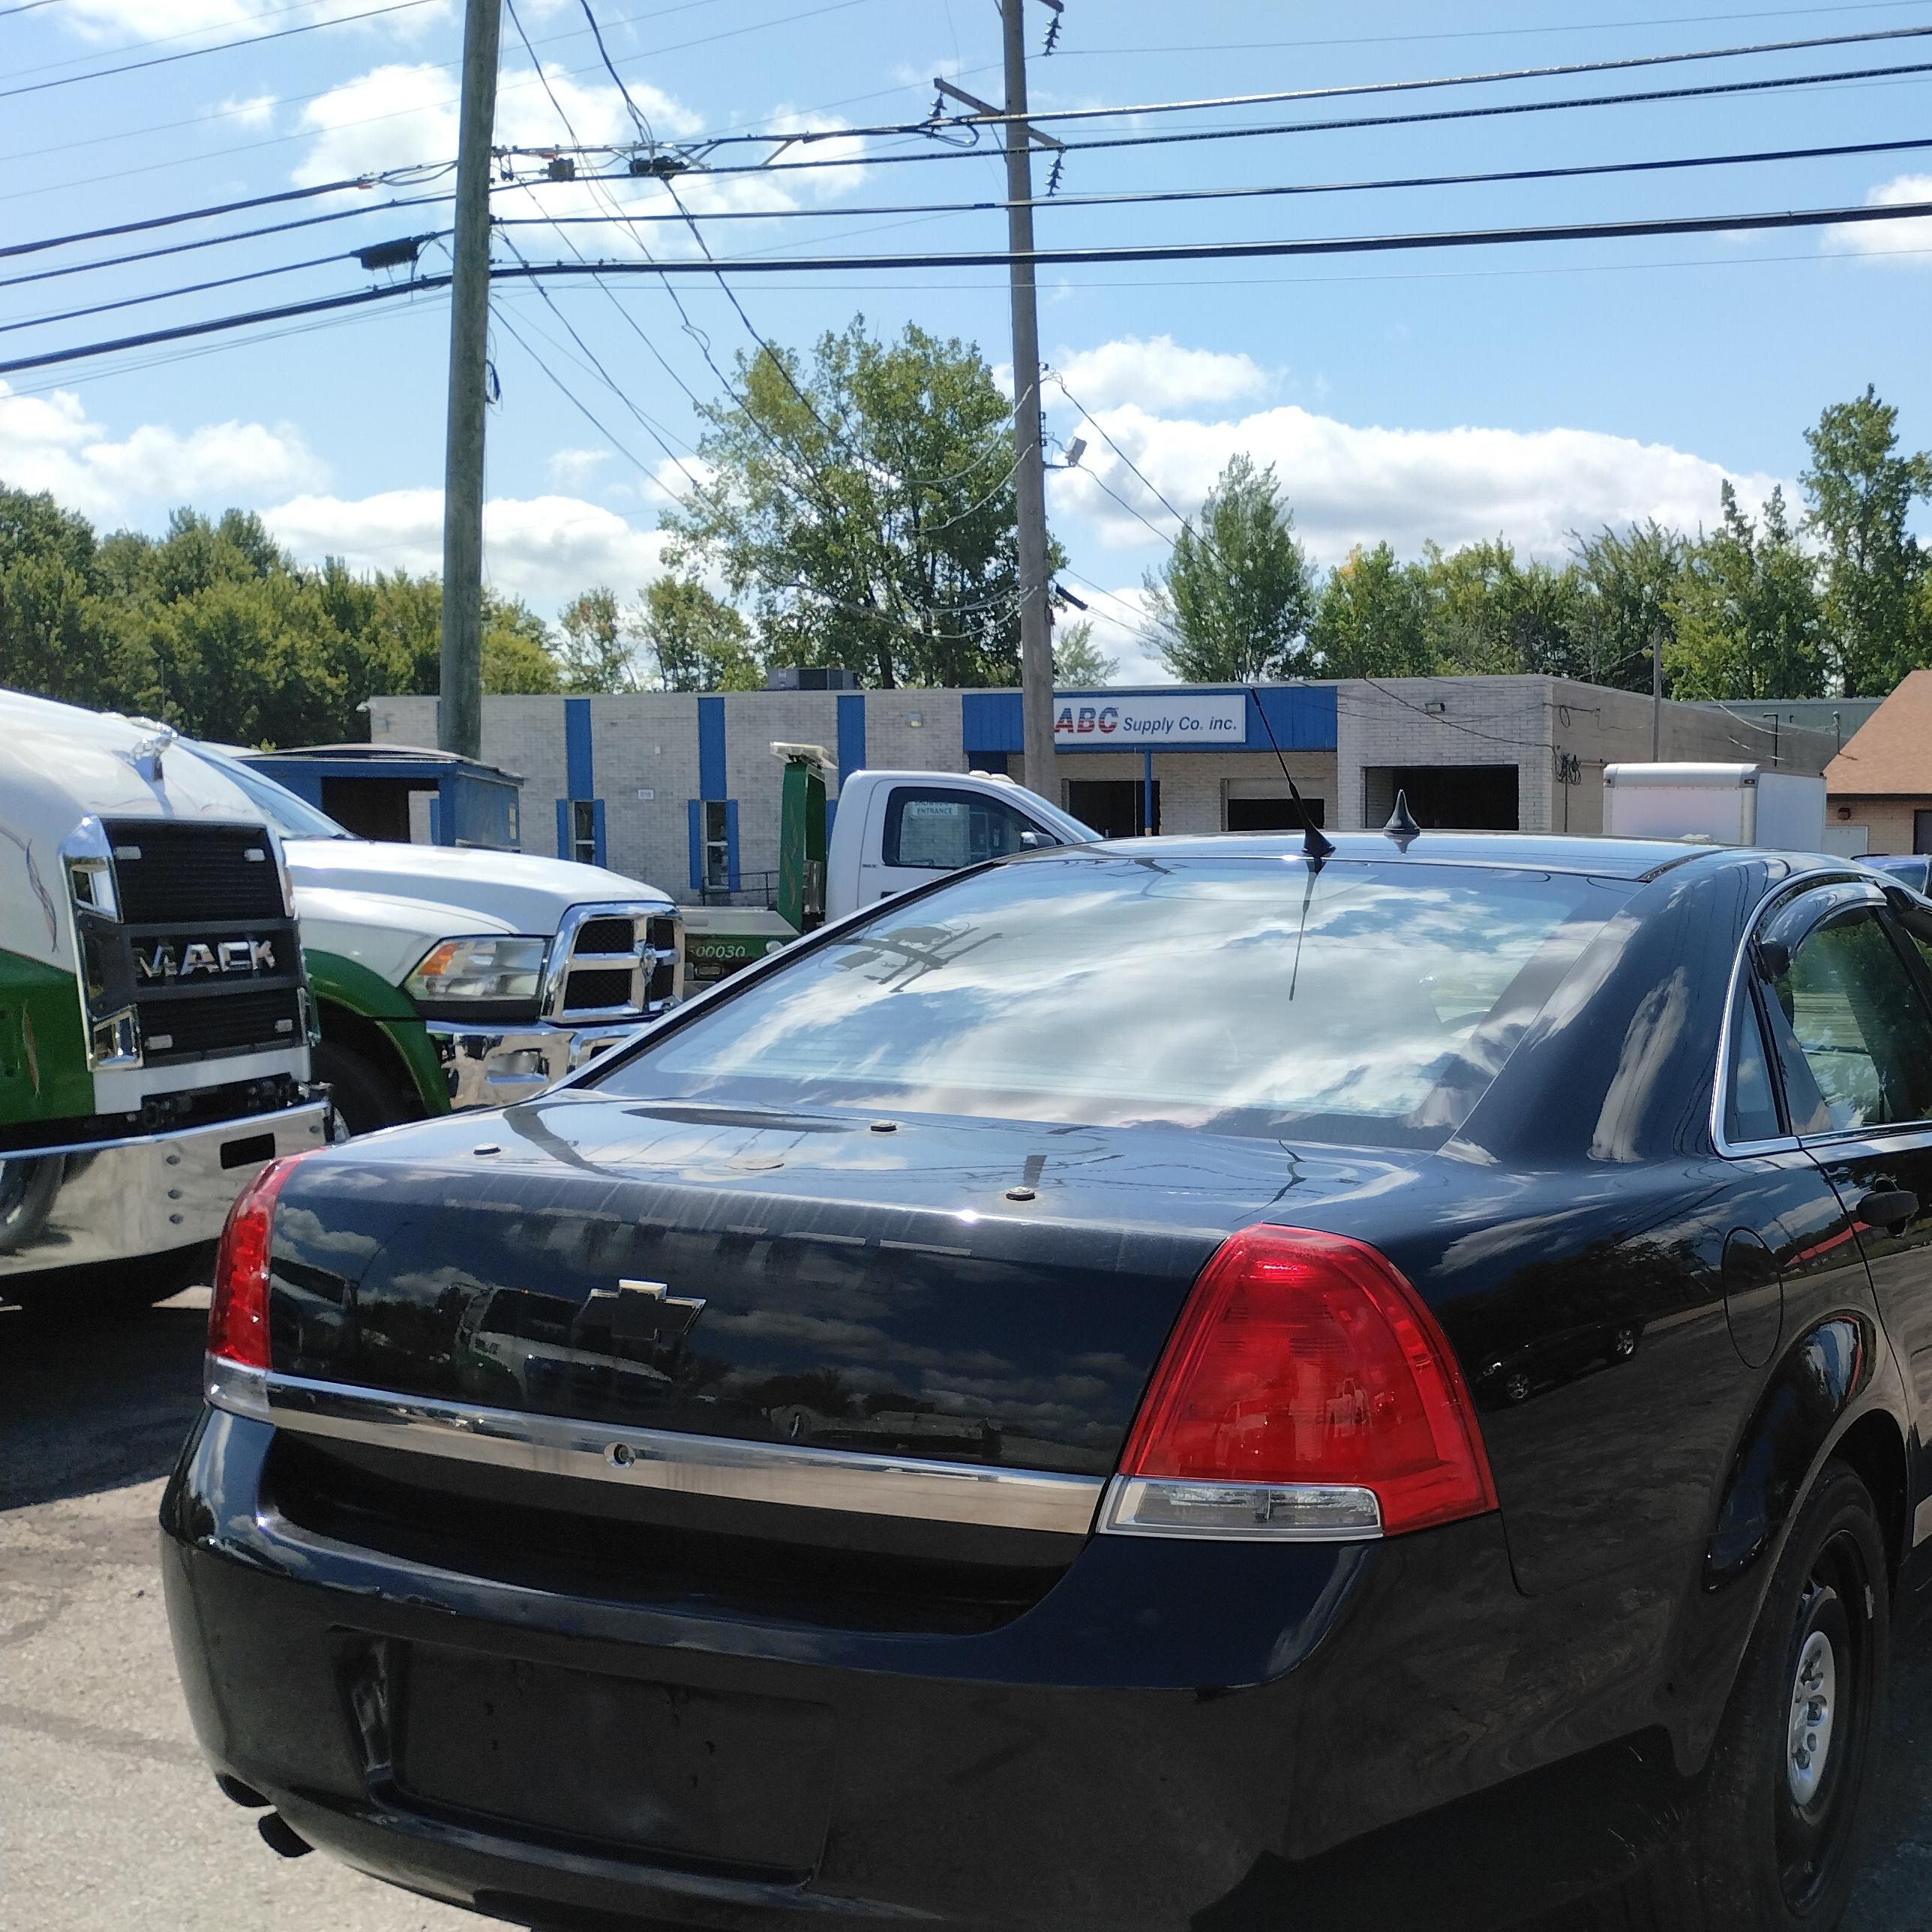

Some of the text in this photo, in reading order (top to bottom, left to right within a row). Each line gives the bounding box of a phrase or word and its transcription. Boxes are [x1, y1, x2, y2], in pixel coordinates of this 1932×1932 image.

[1053, 706, 1237, 736] ABC Supply Co. inc.
[916, 807, 952, 815] ENTRANCE
[133, 939, 277, 978] MACK
